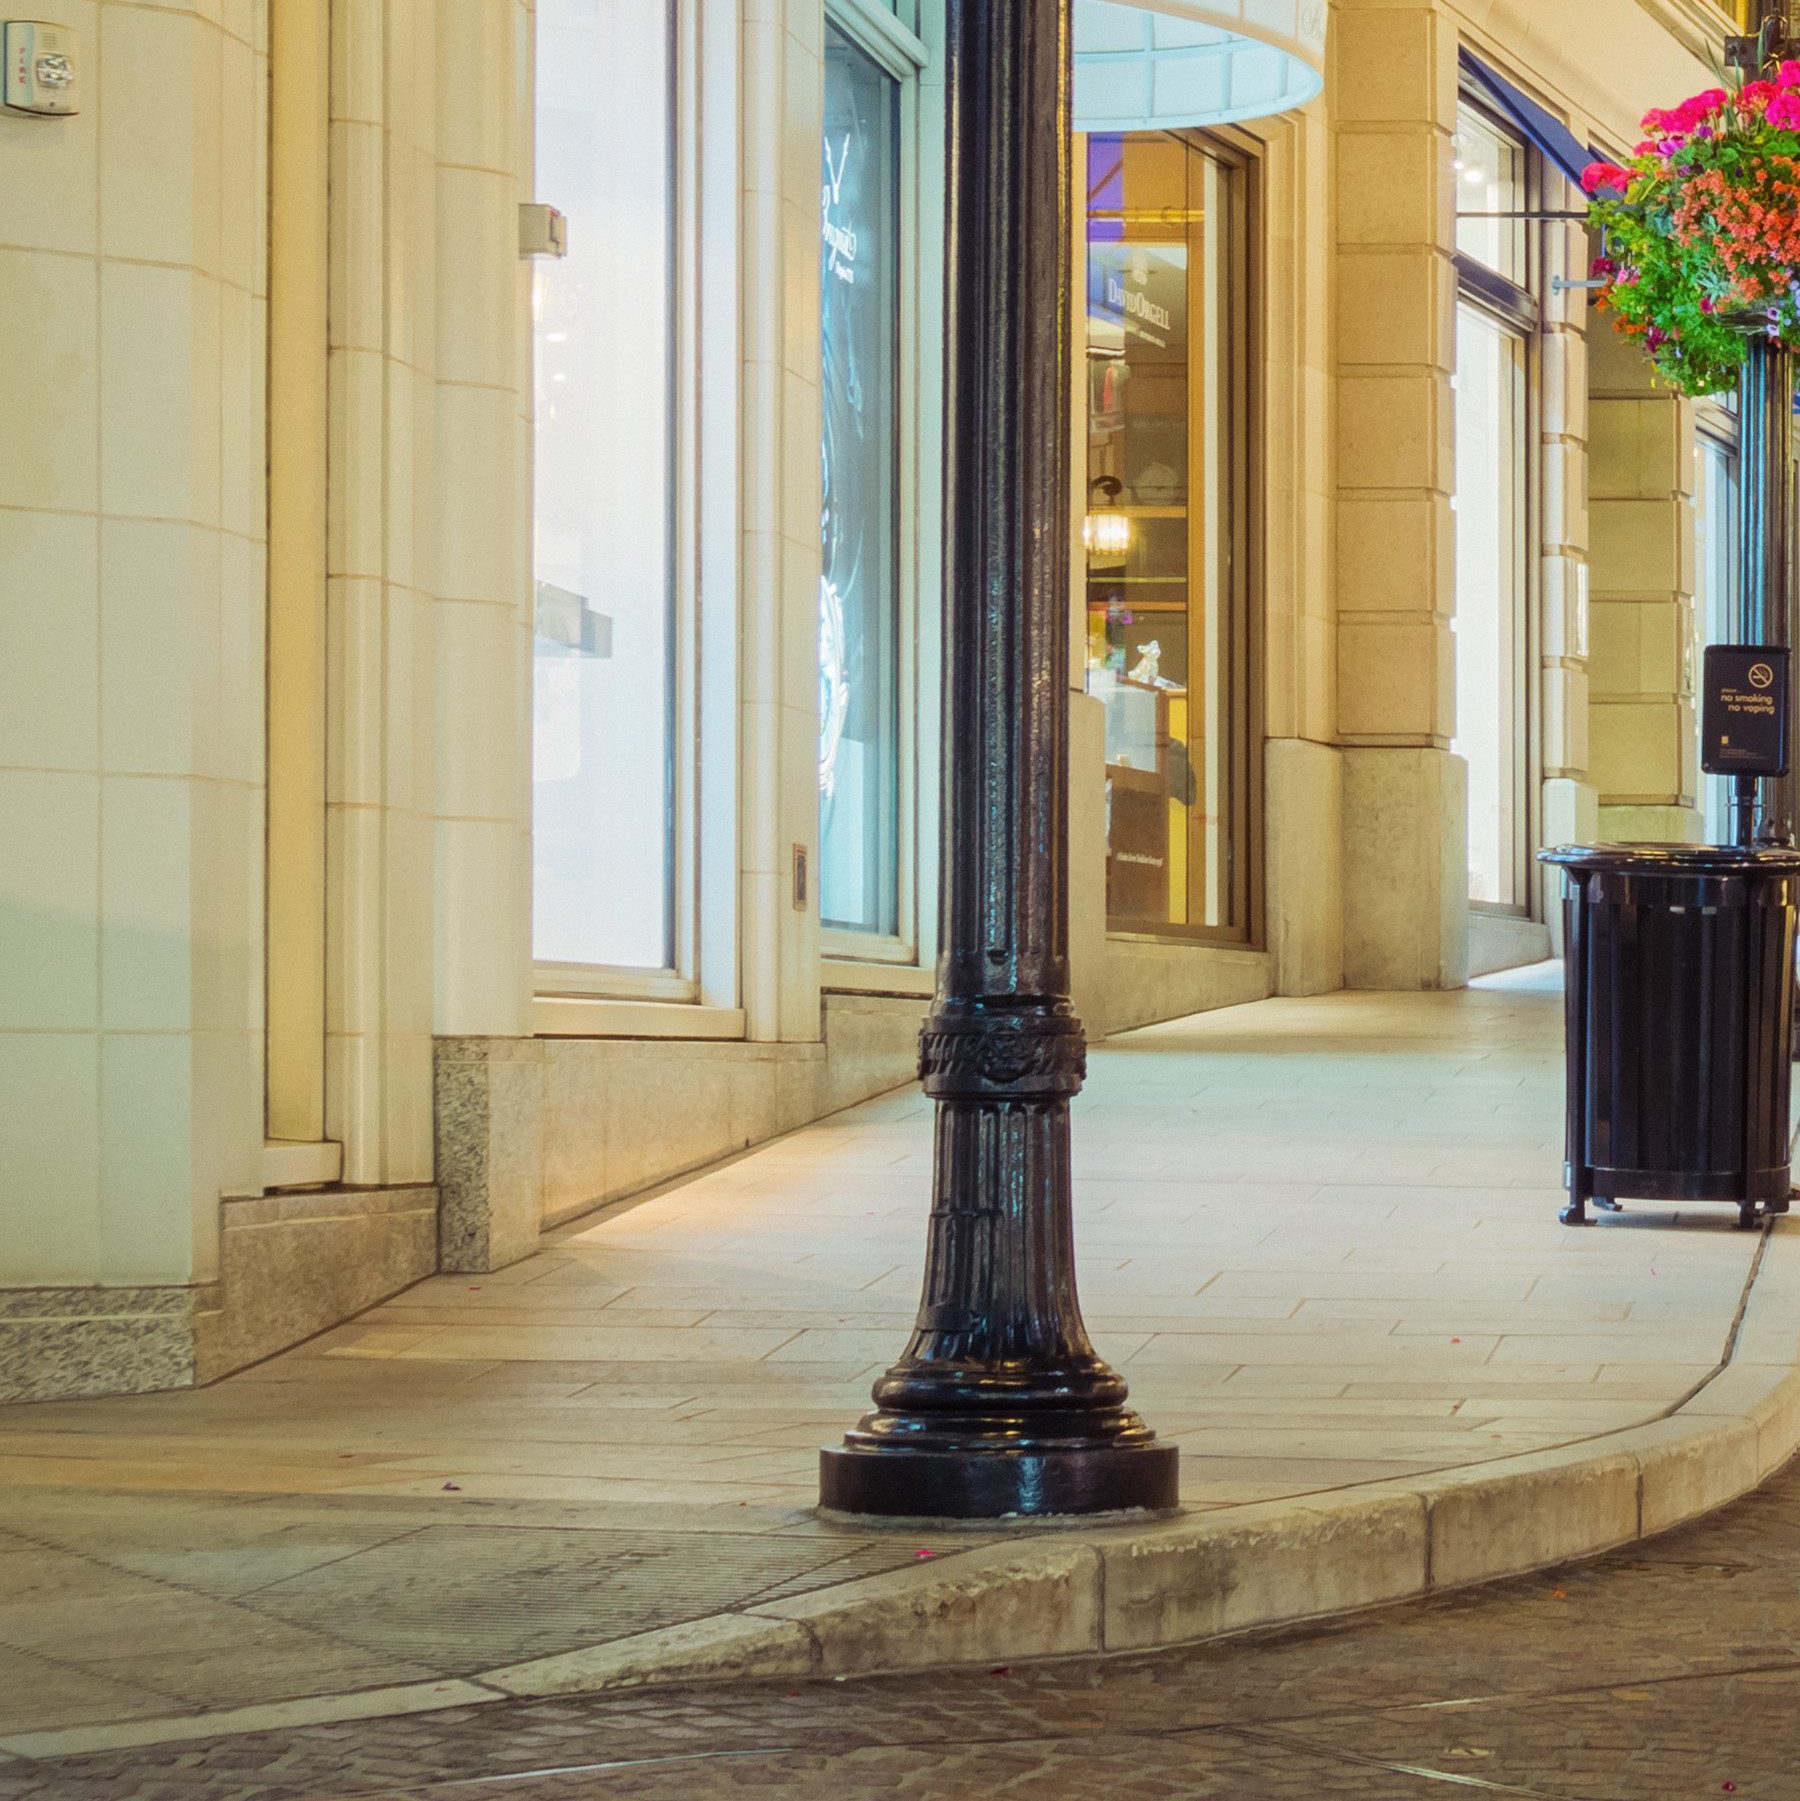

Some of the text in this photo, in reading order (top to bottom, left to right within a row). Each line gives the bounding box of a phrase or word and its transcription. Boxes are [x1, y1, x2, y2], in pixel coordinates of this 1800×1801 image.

[1720, 693, 1773, 705] no smoking
[1743, 704, 1775, 715] vaping
